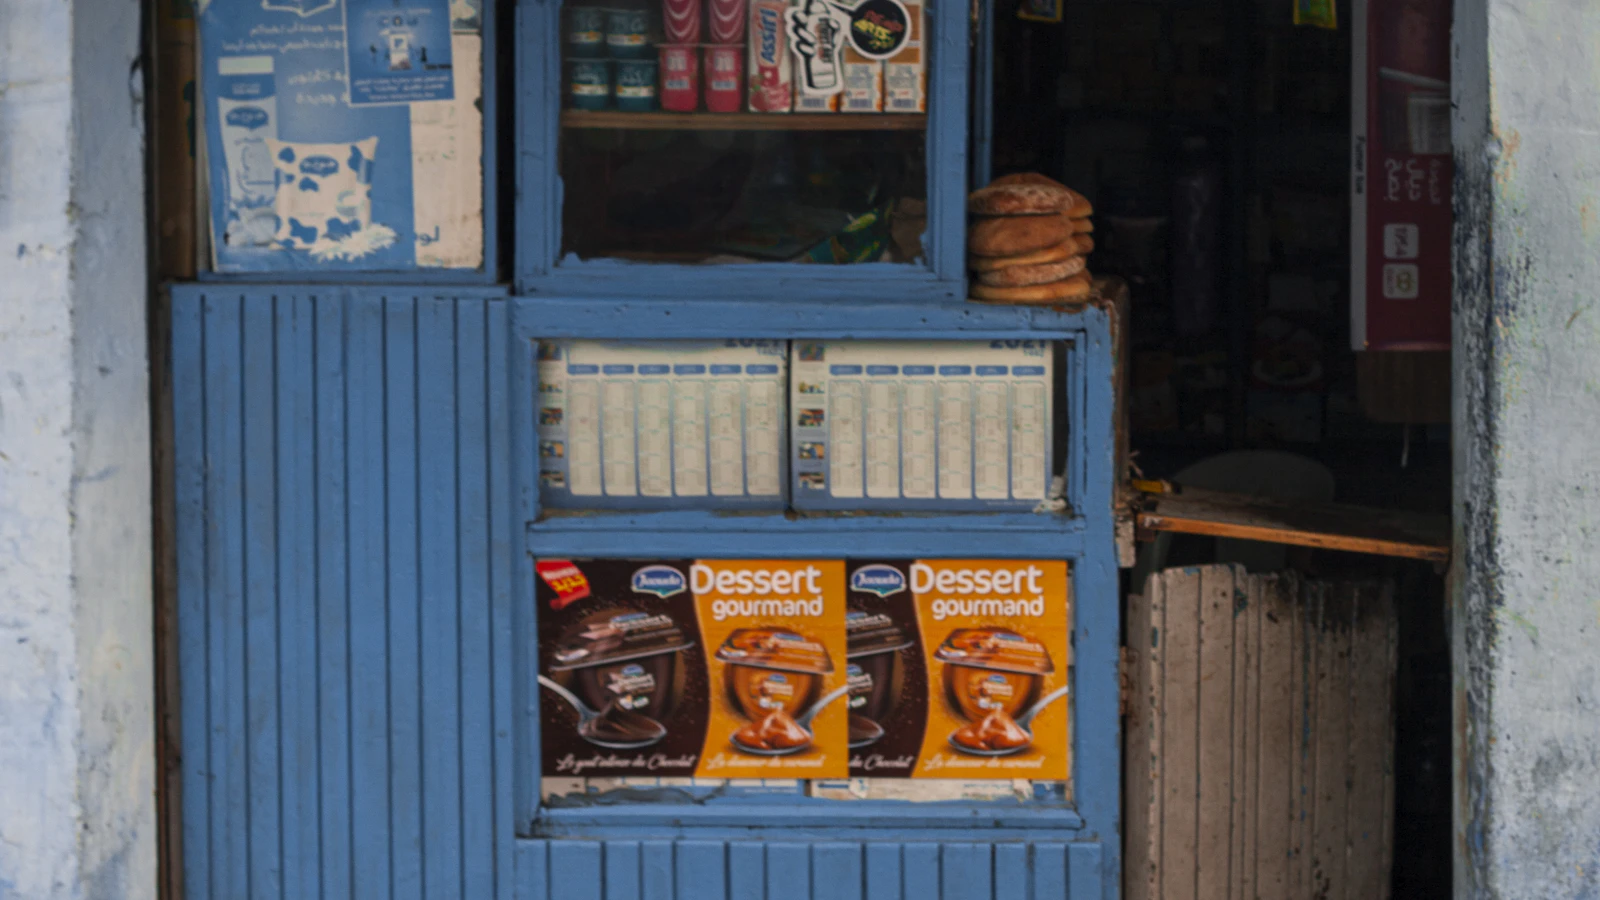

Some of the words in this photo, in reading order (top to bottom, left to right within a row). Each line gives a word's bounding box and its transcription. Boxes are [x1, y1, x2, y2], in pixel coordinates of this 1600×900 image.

[689, 564, 822, 595] Dessert
[909, 563, 1043, 594] Dessert
[712, 596, 824, 621] gourmand
[931, 595, 1045, 621] gourmand
